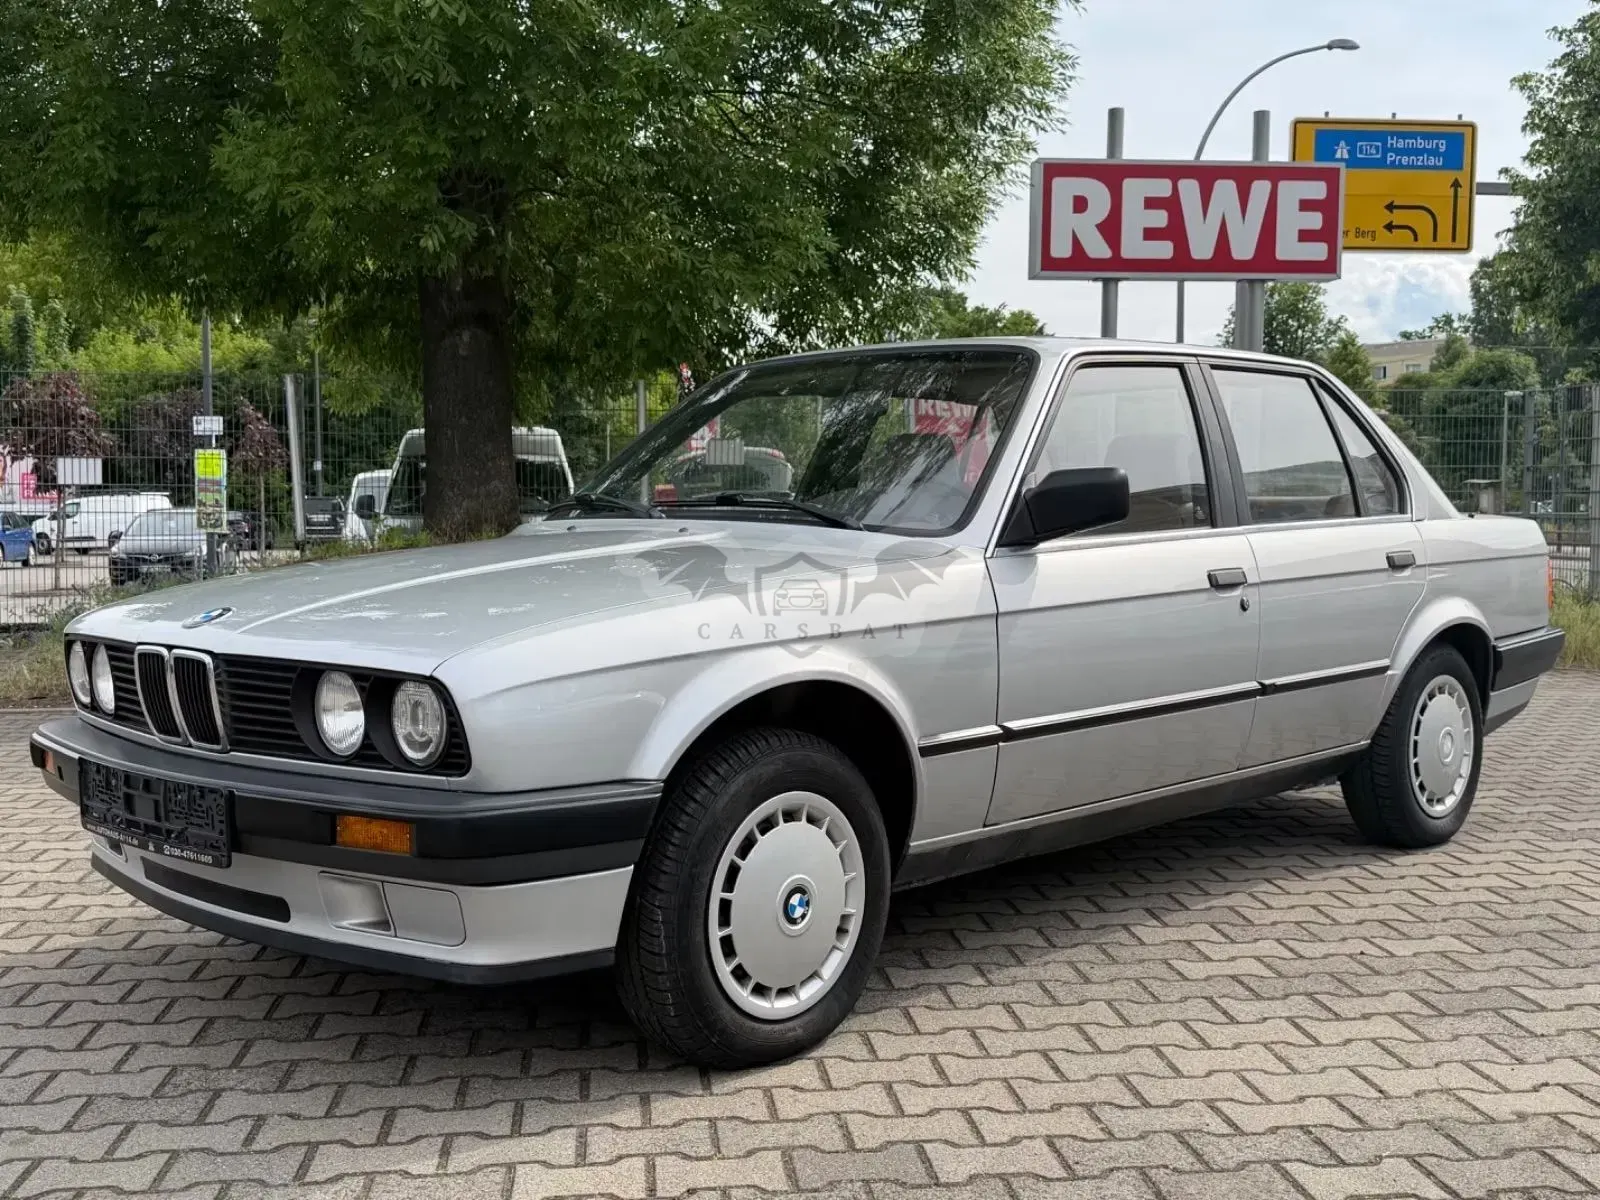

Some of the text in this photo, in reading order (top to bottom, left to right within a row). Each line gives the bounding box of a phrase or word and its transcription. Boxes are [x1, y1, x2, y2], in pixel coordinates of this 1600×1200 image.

[1361, 145, 1377, 155] 114
[1387, 136, 1446, 152] Hamburg
[1387, 153, 1443, 167] Prenzlau
[1050, 176, 1328, 261] REWE
[1355, 227, 1376, 241] Berg
